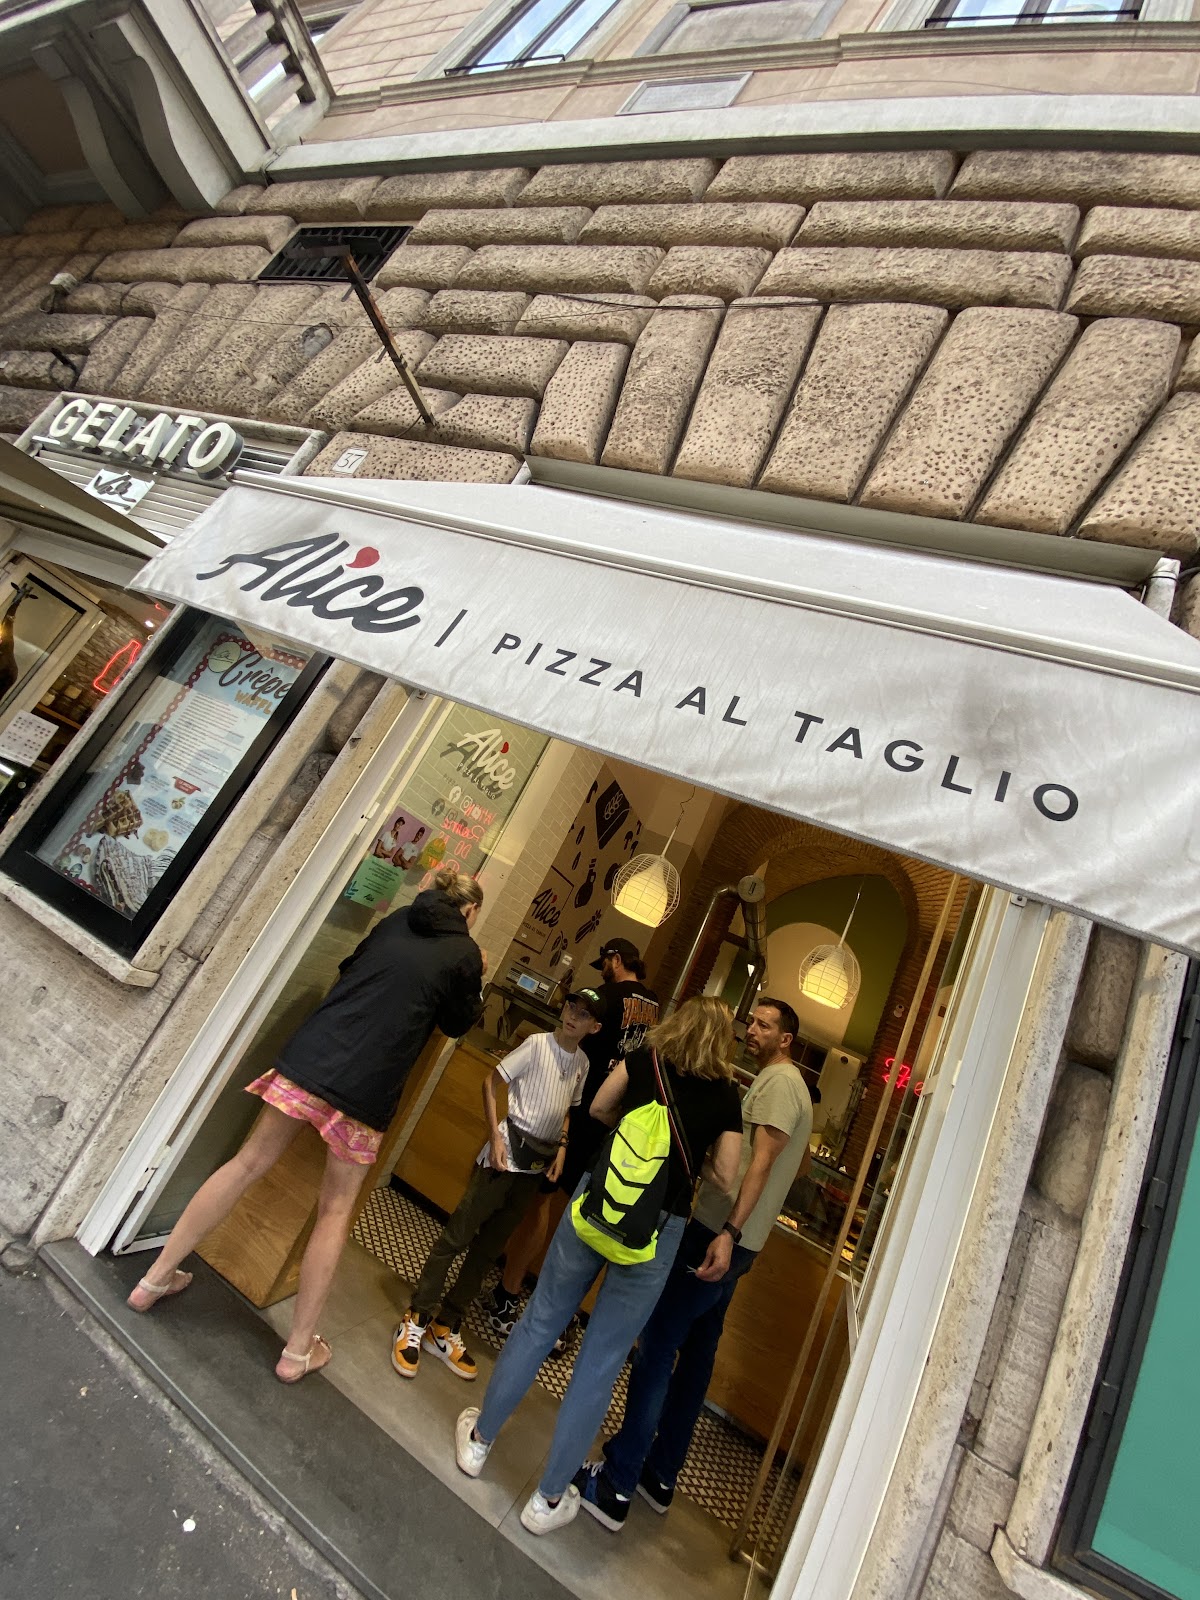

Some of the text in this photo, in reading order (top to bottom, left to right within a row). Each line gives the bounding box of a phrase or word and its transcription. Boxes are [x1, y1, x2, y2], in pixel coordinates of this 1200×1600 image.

[49, 398, 238, 474] GELATO
[337, 452, 364, 469] 37
[196, 532, 1079, 822] Alice PIZZA AL TAGLIO
[456, 728, 516, 790] Alice
[531, 888, 561, 928] Alice
